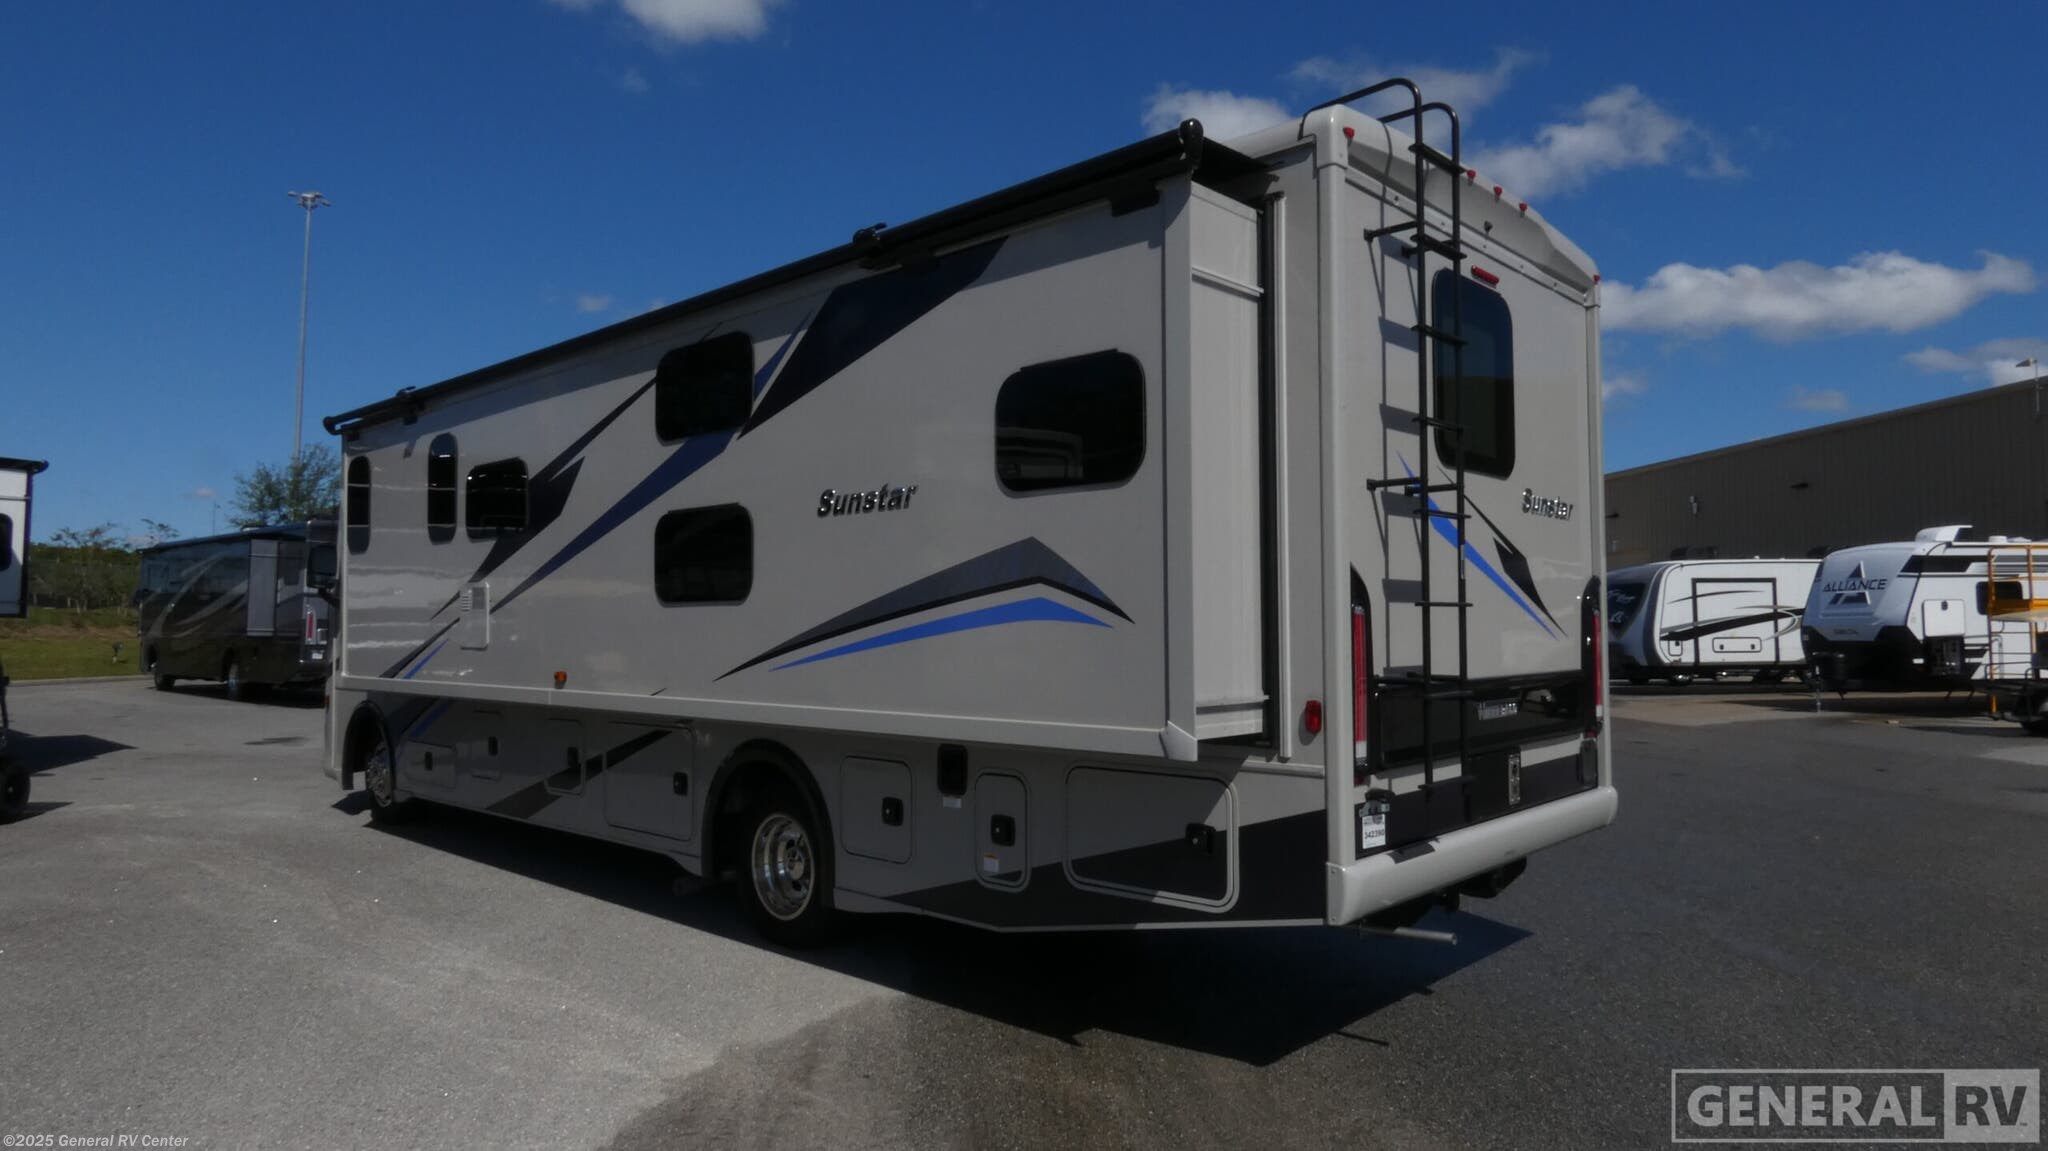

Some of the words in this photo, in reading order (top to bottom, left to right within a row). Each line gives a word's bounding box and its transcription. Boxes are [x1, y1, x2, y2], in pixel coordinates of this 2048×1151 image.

[817, 483, 918, 518] Sunstar
[1521, 488, 1574, 521] Sunstar
[1823, 578, 1887, 592] ALLIANCE
